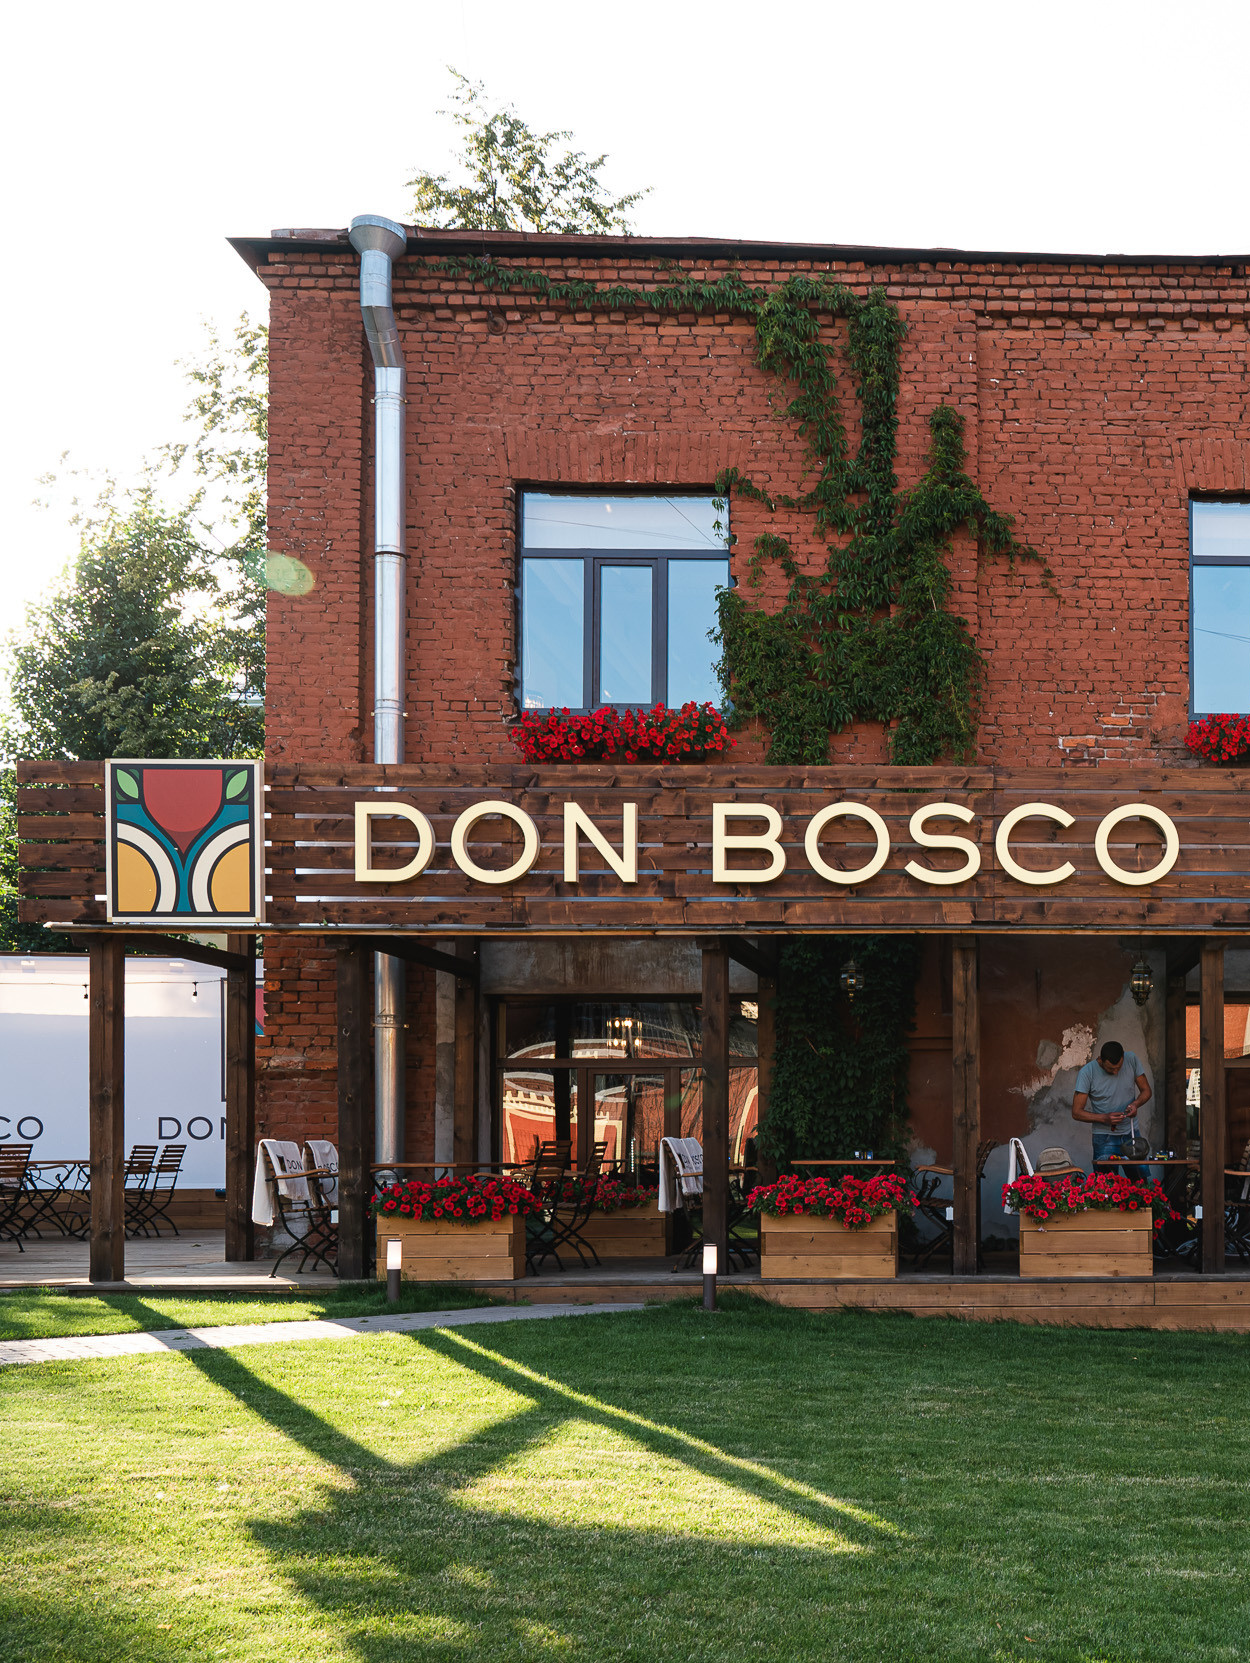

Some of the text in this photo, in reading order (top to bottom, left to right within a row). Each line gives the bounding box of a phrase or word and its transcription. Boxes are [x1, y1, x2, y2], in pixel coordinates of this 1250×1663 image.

[354, 800, 1181, 886] DON BOSCO
[158, 1116, 227, 1140] DO
[286, 1159, 303, 1171] DON
